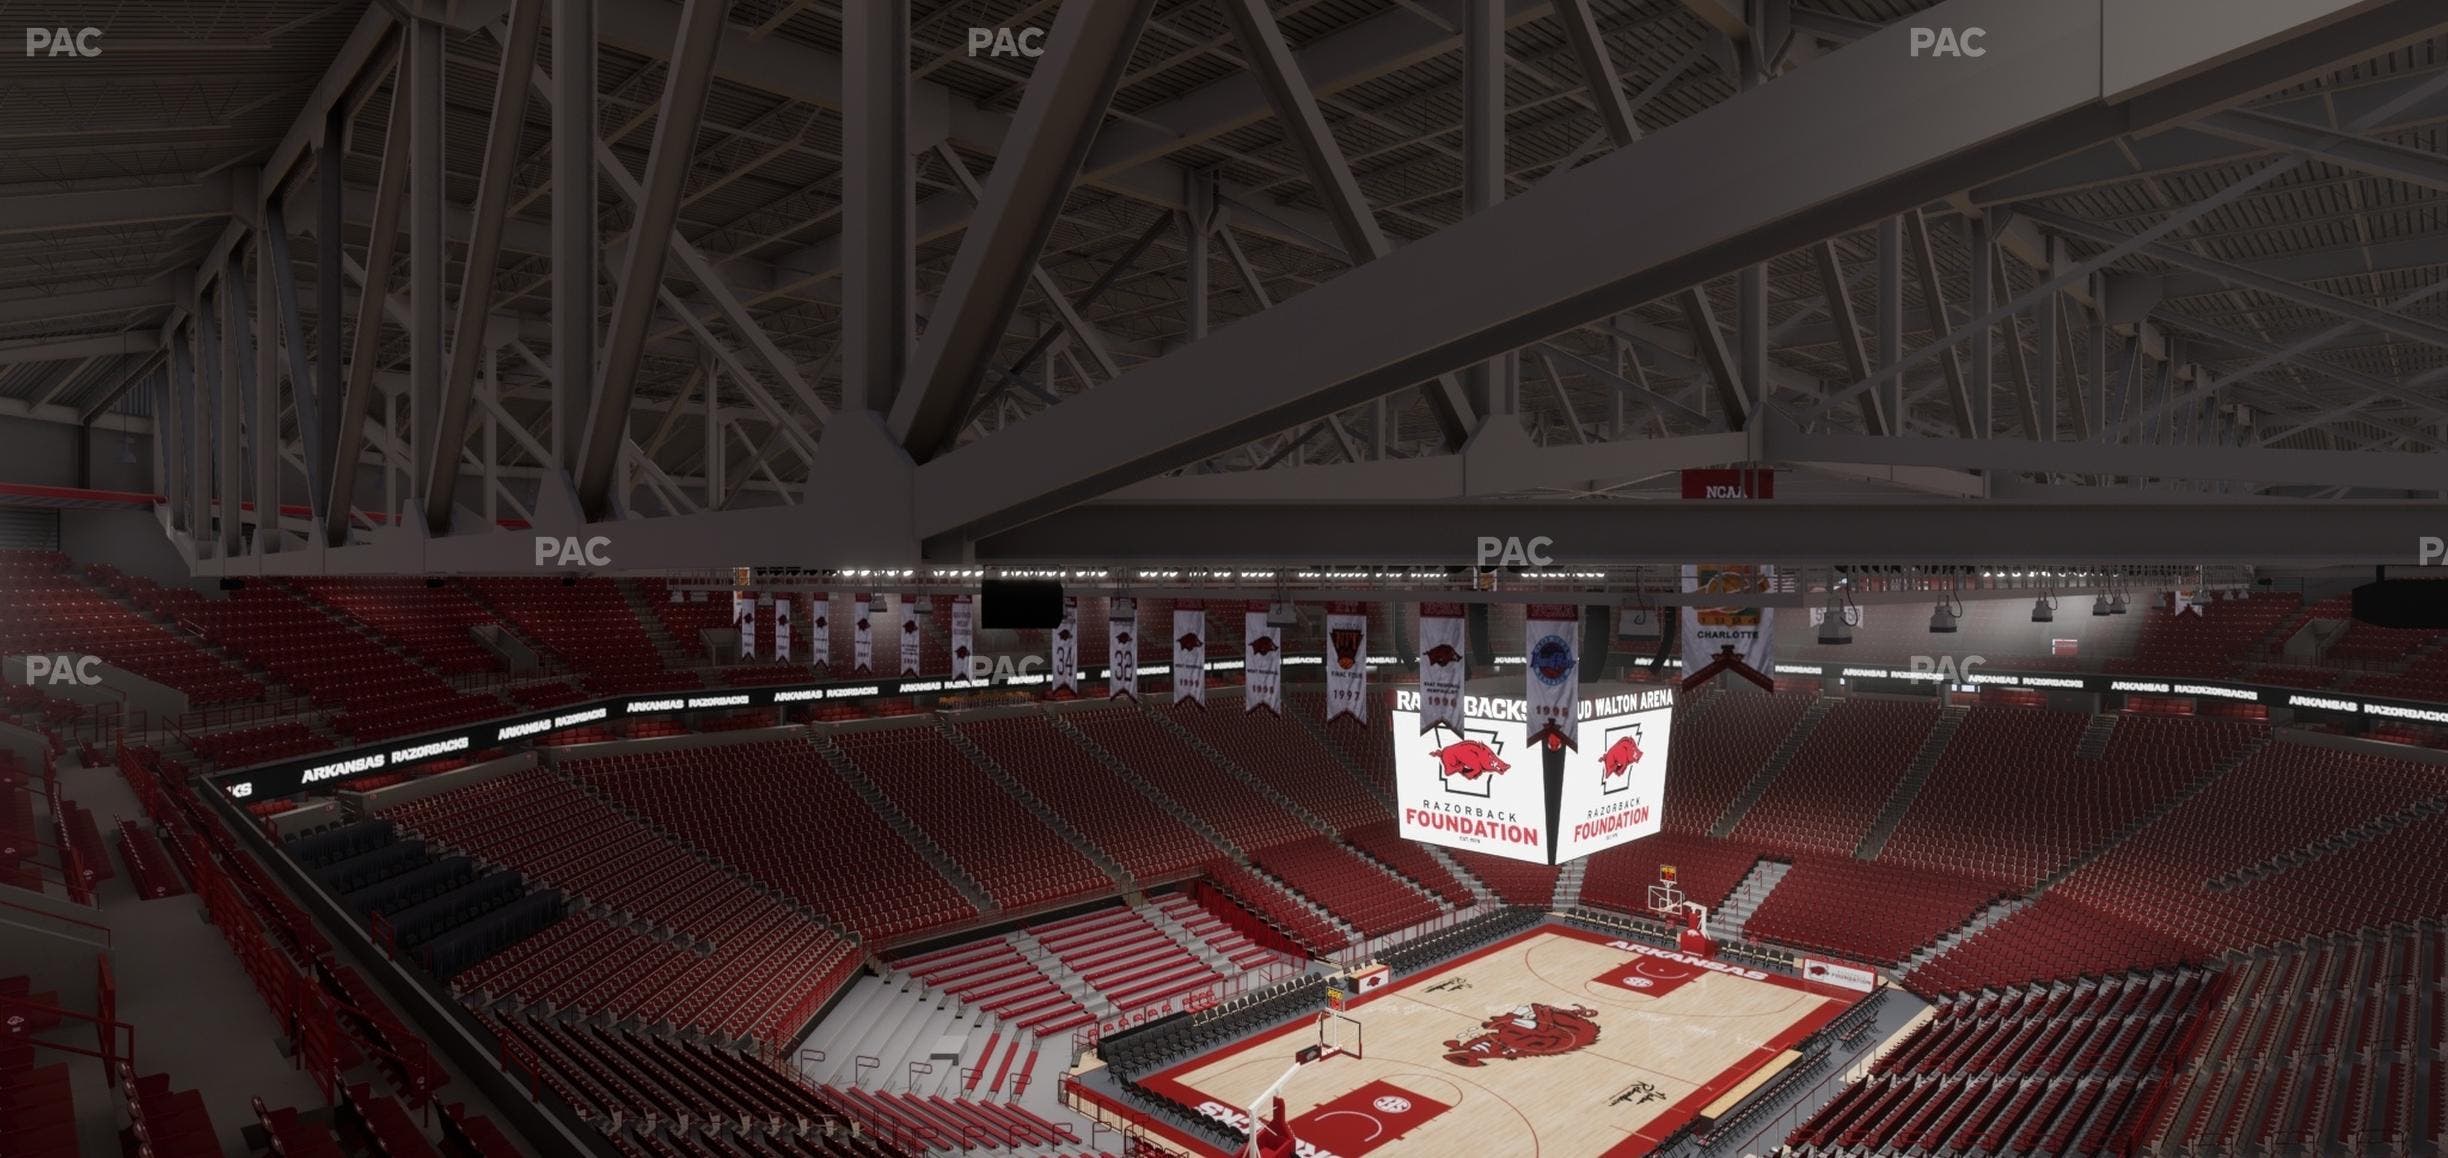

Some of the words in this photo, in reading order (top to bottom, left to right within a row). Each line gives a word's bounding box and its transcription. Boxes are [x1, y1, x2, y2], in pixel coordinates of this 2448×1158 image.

[1696, 630, 1759, 639] CHARLOTTE
[1056, 646, 1073, 677] 34
[1114, 650, 1133, 682] 32
[899, 682, 941, 693] ARKANSAS
[1968, 674, 2019, 685] ARKANSAS
[2111, 681, 2170, 693] ARKANSAS
[627, 699, 685, 713] ARKANSAS
[689, 695, 749, 708] RAZORBACKS
[774, 689, 823, 702] ARKANSAS
[1333, 689, 1360, 701] 1997
[1595, 693, 1638, 717] WALTON
[1640, 688, 1674, 711] ARENA
[2289, 695, 2358, 712] ARKANSAS
[498, 719, 552, 741] ARKANSAS
[554, 708, 607, 727] RAZORBACKS
[301, 754, 385, 784] ARKANSAS
[391, 737, 469, 764] RAZORBACKS
[1423, 799, 1518, 823] RAZORBACK
[1588, 797, 1641, 819] RAZORBACK
[1406, 808, 1538, 846] FOUNDATION
[1573, 806, 1649, 843] FOUNDATION
[1606, 940, 1768, 981] ARKANSAS
